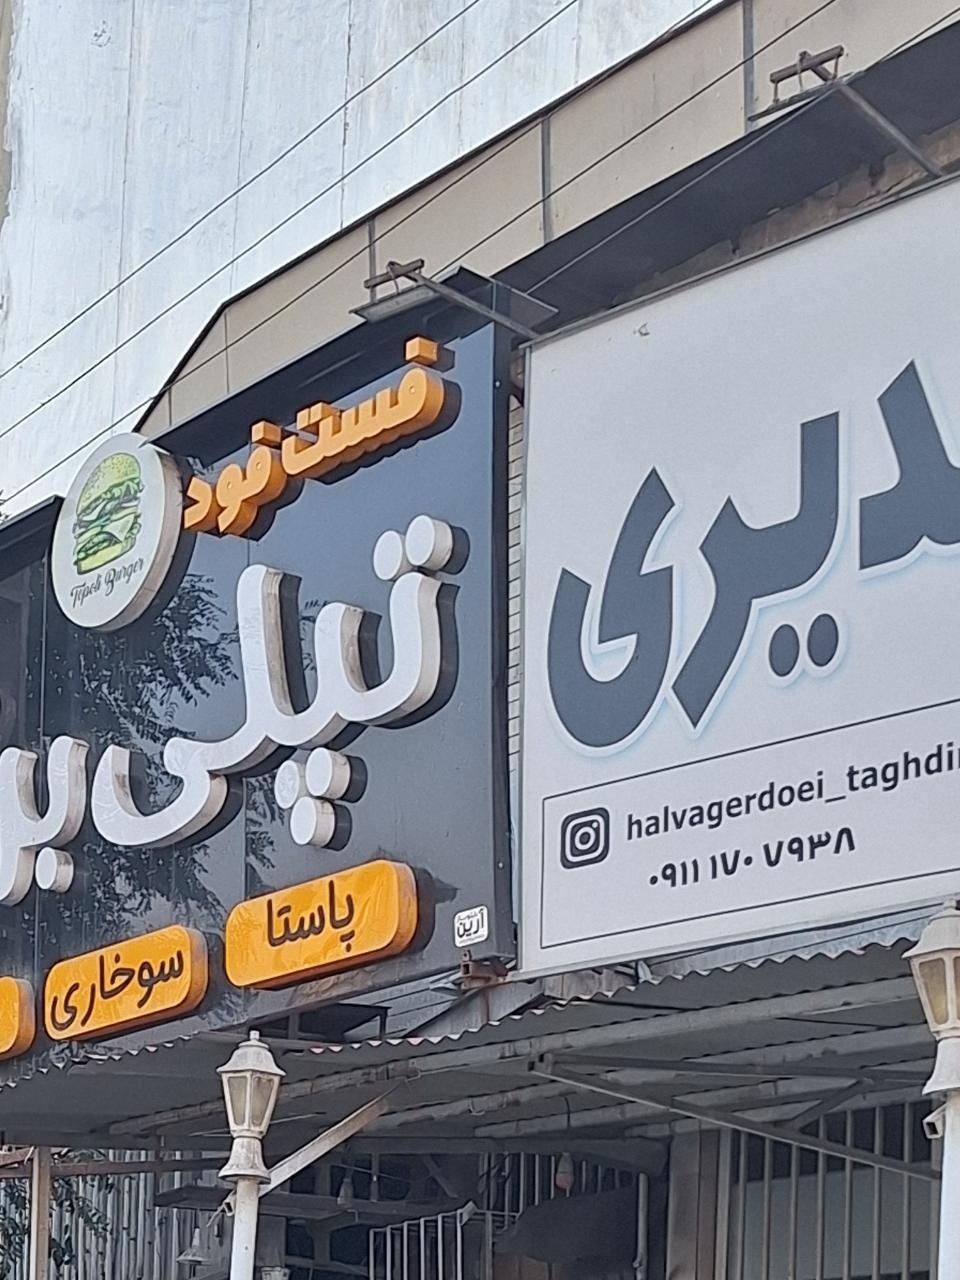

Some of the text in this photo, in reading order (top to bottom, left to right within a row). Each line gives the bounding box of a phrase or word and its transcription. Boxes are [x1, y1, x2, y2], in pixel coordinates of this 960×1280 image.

[183, 336, 445, 536] فست فود
[104, 557, 144, 597] Burger
[547, 358, 960, 748] دیری
[91, 513, 454, 851] تپلی
[649, 826, 856, 888] ۰۹۱۱ ۱۷۰ ۷۹۳۸
[267, 879, 357, 952] پاستا
[457, 908, 484, 938] آرین
[50, 943, 185, 1031] سوخاری
